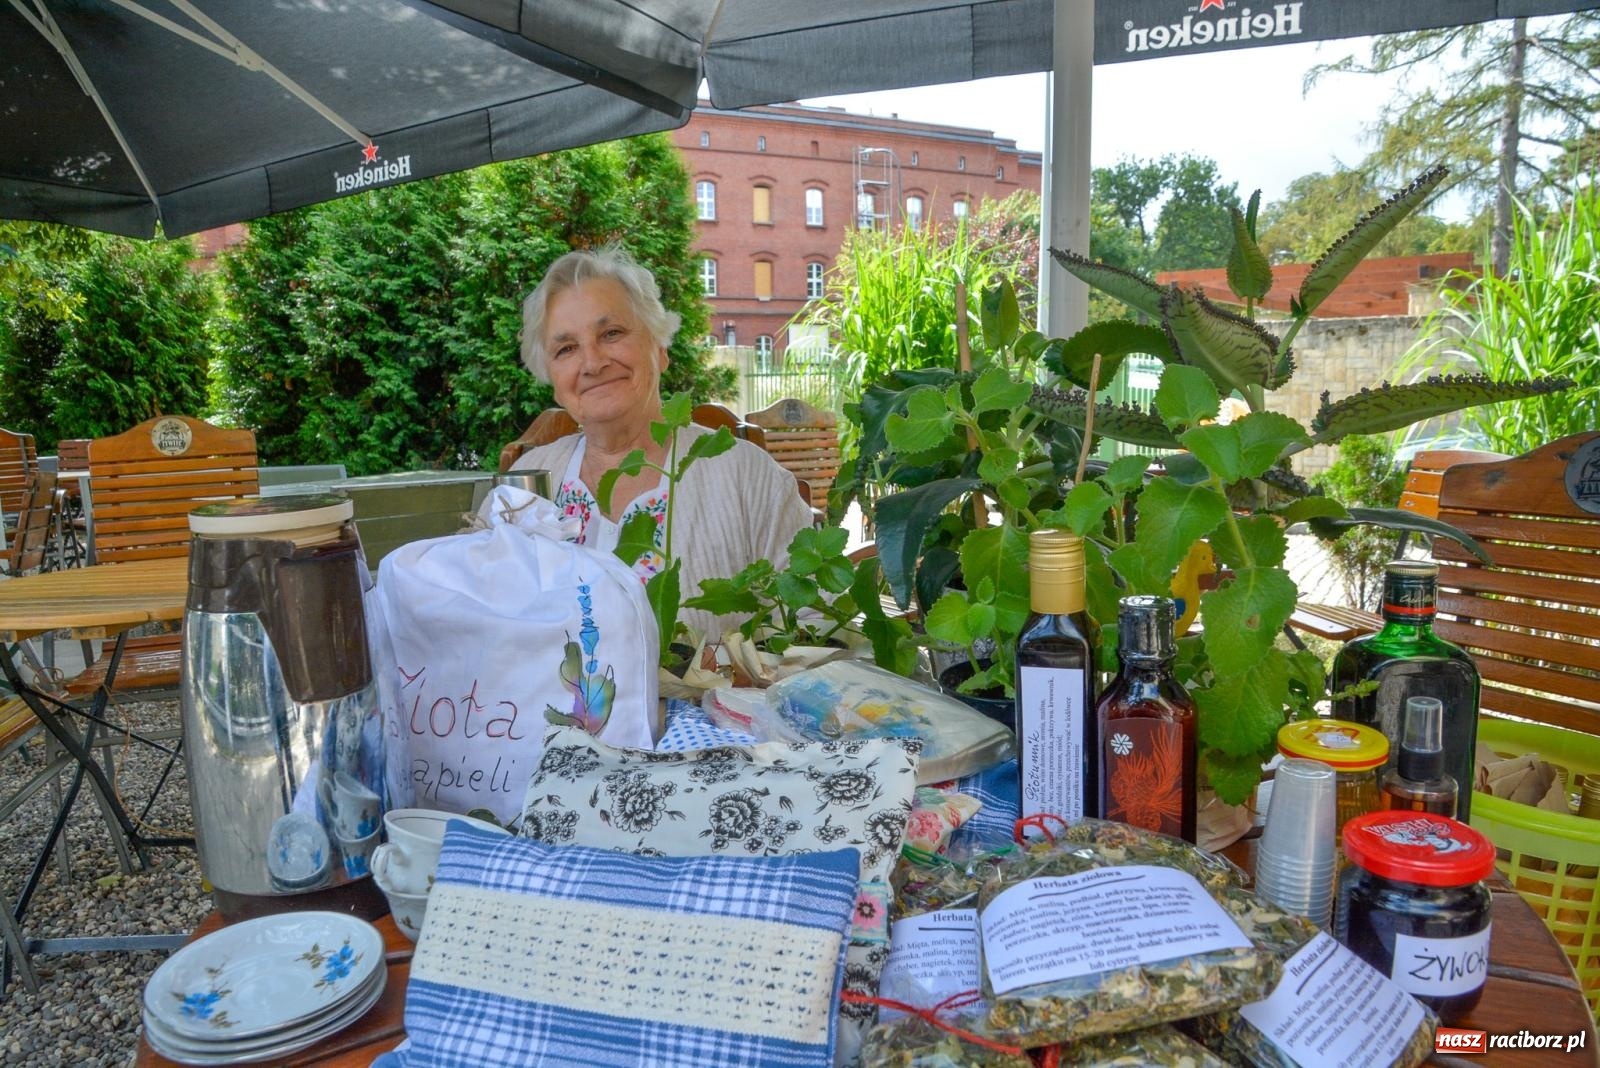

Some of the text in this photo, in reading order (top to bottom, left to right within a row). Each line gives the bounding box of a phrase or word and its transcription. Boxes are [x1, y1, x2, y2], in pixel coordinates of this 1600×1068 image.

[411, 756, 517, 801] ąpieli
[1033, 870, 1121, 890] Herbata ziołowa
[932, 913, 973, 923] Herbata
[1066, 955, 1077, 964] na
[1089, 959, 1105, 971] lub
